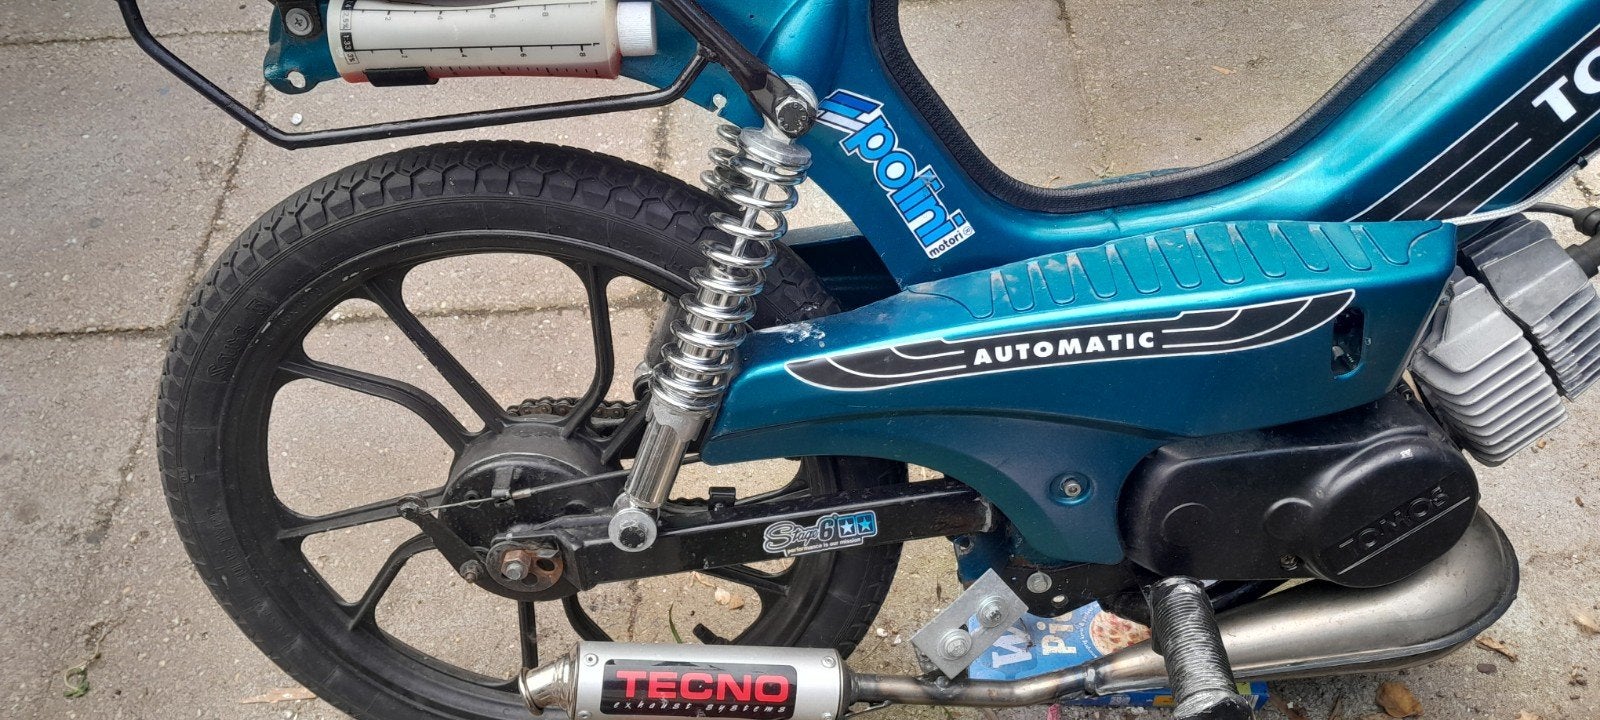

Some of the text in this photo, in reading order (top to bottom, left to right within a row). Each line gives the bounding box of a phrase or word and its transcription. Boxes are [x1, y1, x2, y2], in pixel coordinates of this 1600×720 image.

[841, 113, 967, 249] polini
[928, 230, 964, 257] motori
[973, 331, 1155, 366] AUTOMATIC
[1337, 486, 1449, 558] TOMOS
[616, 670, 789, 703] TECNO
[613, 700, 786, 713] exhaust systems
